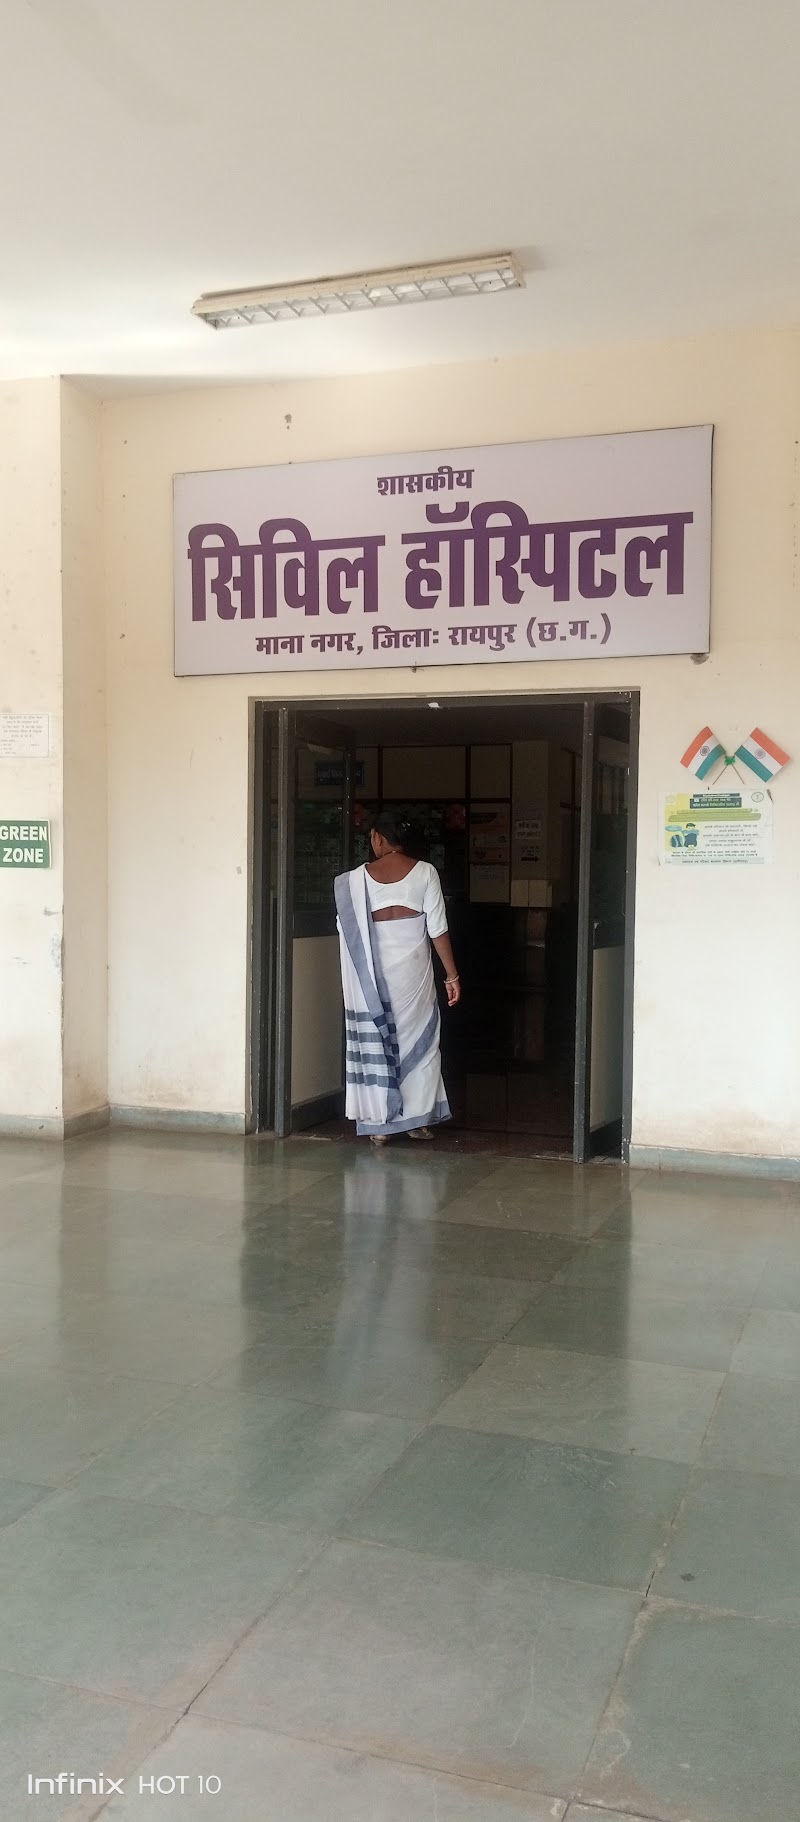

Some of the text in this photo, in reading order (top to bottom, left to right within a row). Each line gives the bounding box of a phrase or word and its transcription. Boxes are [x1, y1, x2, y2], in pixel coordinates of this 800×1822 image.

[377, 466, 474, 496] शासकीय
[187, 501, 693, 622] सिविल हॉस्पिटल
[255, 635, 304, 655] माना
[310, 632, 363, 655] नगर,
[448, 624, 517, 651] रायपुर
[526, 613, 612, 648] (छ.ग.)
[0, 825, 47, 841] GREEN
[3, 847, 44, 863] ZONE
